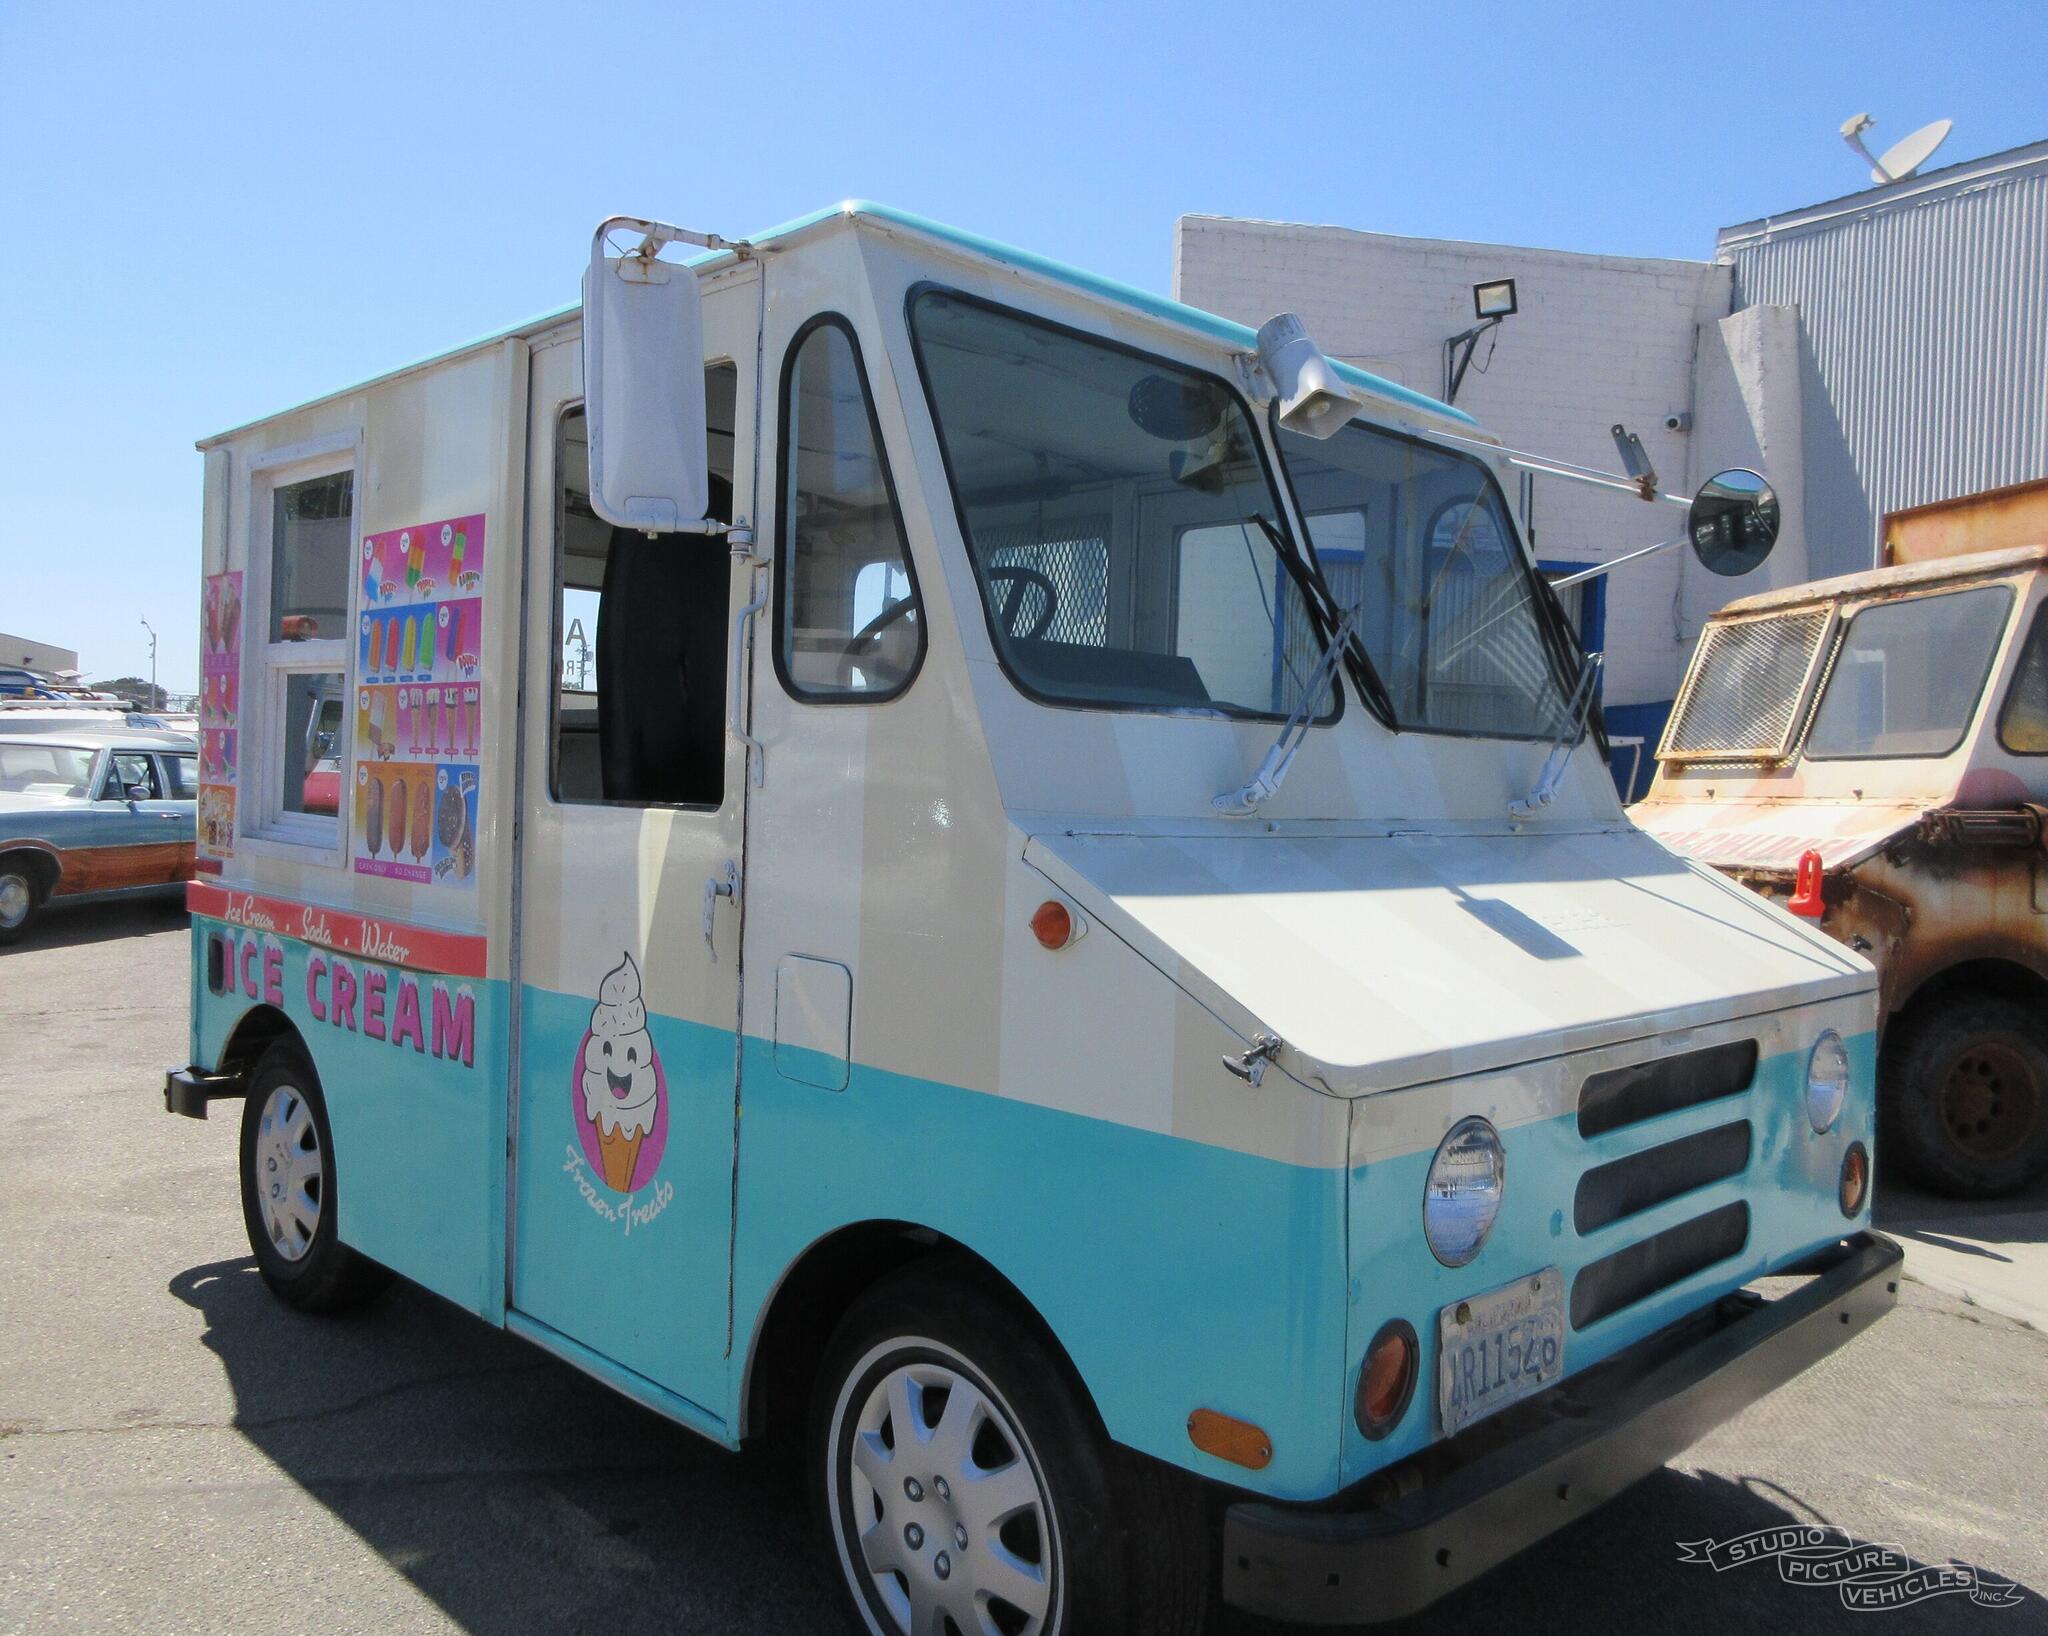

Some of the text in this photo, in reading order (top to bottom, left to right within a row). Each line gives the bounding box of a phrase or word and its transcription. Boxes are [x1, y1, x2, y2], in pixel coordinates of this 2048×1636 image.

[225, 891, 410, 963] Ice Cream Soda Water
[222, 927, 475, 1069] ICE CREAM
[618, 1179, 673, 1236] Treats
